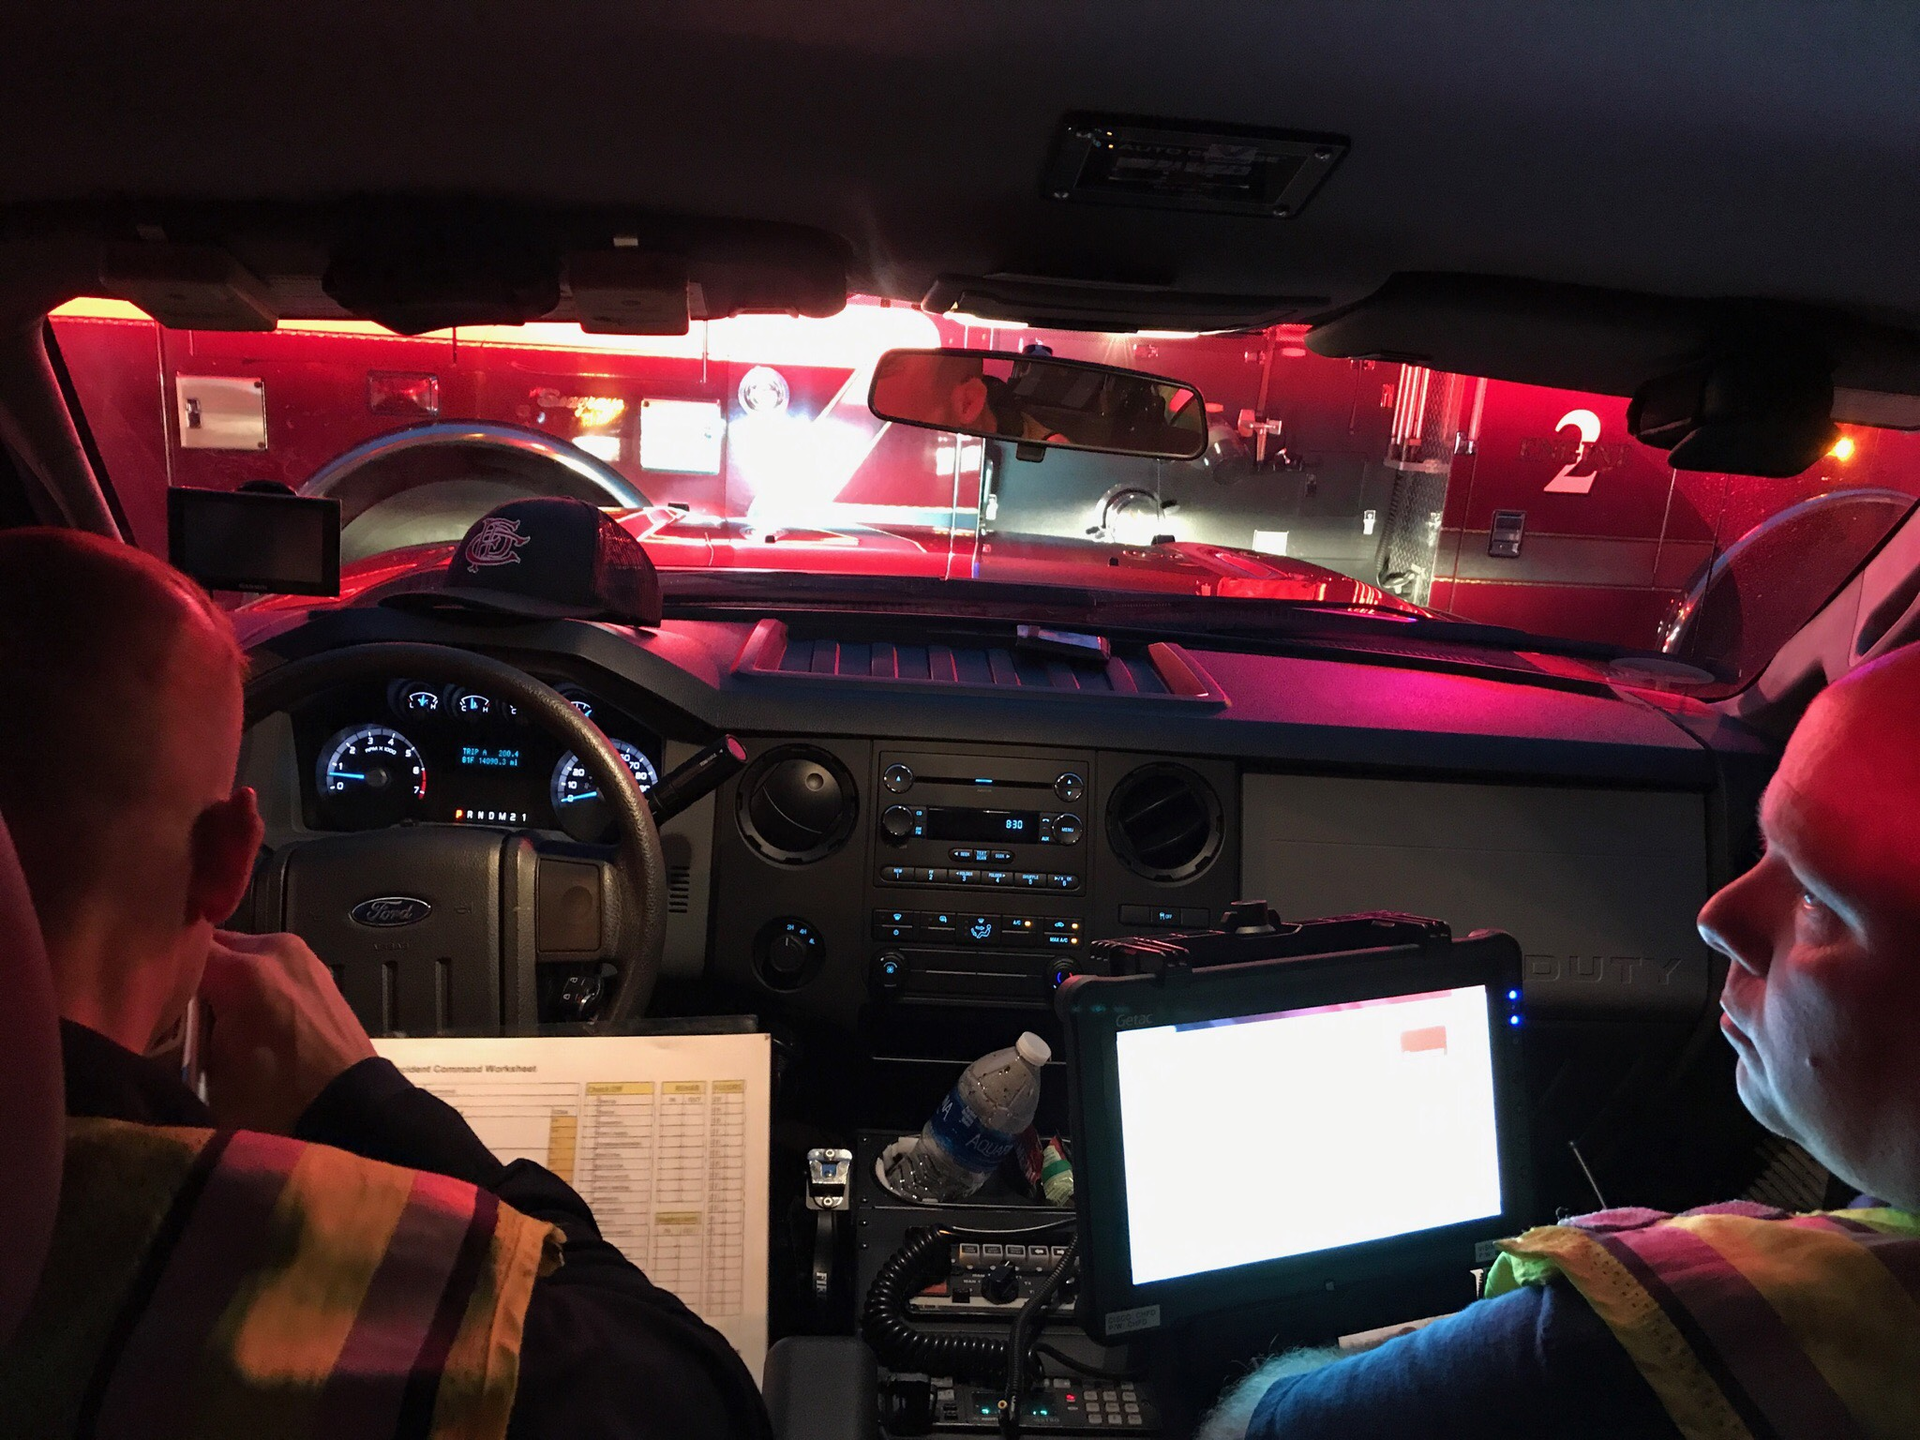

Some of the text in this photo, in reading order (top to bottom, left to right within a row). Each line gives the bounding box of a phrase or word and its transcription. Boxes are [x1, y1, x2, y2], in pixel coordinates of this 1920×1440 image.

[1543, 408, 1601, 494] 2
[367, 736, 374, 745] 3
[387, 738, 395, 746] 4
[349, 746, 356, 755] 2
[404, 749, 412, 758] 5
[462, 747, 479, 755] TRIP
[338, 762, 343, 771] 1
[629, 761, 640, 769] 70
[412, 765, 420, 775] 6
[572, 768, 585, 777] 20
[635, 771, 647, 780] 80
[336, 781, 344, 790] 0
[413, 785, 420, 794] 7
[567, 781, 577, 790] 10
[455, 809, 527, 822] P R N D M 2 1
[1005, 819, 1023, 830] 8:30
[366, 900, 413, 921] Ford
[1523, 954, 1683, 986] DUTY
[1115, 1013, 1153, 1027] Getac
[398, 1064, 537, 1073] cident Command Worksheet
